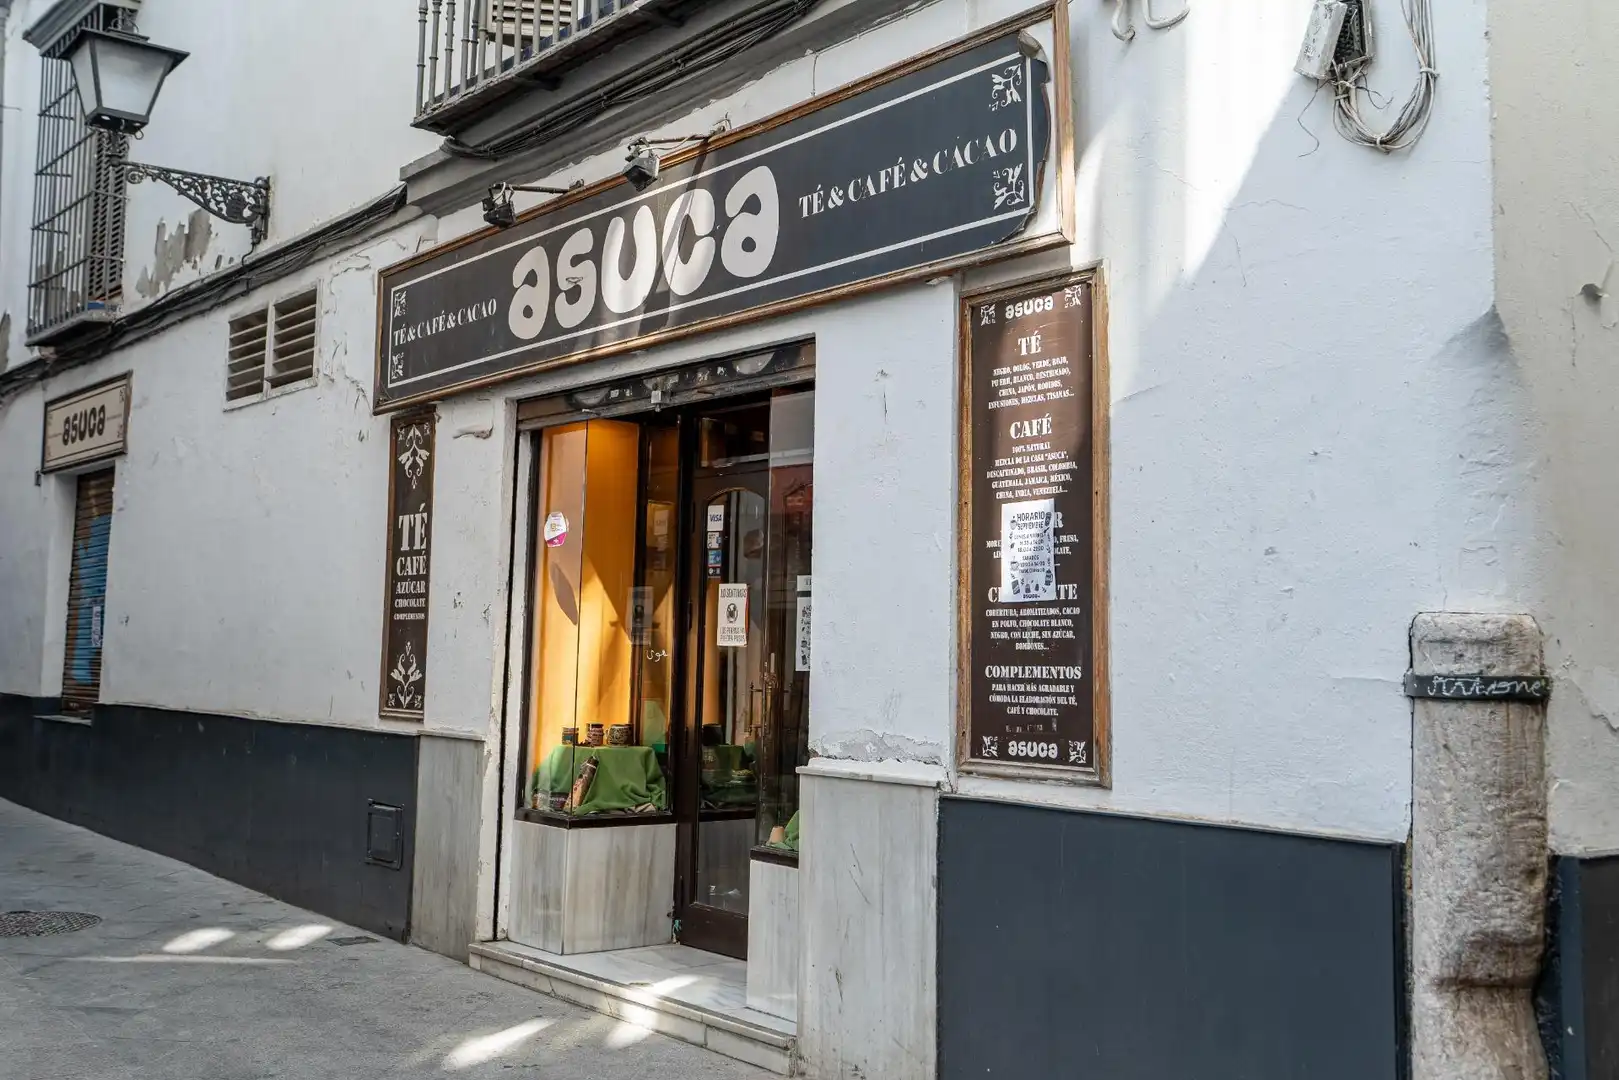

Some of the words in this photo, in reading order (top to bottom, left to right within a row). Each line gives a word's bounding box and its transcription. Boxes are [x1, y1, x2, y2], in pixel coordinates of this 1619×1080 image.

[508, 165, 780, 340] asuca
[1005, 296, 1053, 319] asuca
[1017, 330, 1041, 356] TÉ
[993, 367, 1012, 376] NEGRO,
[1032, 359, 1051, 369] VERDE,
[63, 404, 105, 446] asuca
[1010, 413, 1052, 439] CAFÉ
[1027, 442, 1050, 451] NATURAL
[1031, 454, 1044, 462] CASA
[709, 514, 722, 522] VISA
[1017, 511, 1045, 521] HORARIO
[399, 503, 428, 551] TÉ
[396, 550, 427, 577] CAFÉ
[395, 578, 426, 595] AZÚCAR
[395, 598, 426, 608] CHOCOLATE
[1051, 619, 1073, 627] BLANCO,
[991, 631, 1009, 639] NEGRO,
[1022, 631, 1040, 639] LECHE,
[1052, 629, 1075, 639] AZÚCAR,
[985, 666, 1081, 679] COMPLEMENTOS
[1007, 684, 1024, 692] HACER
[1026, 683, 1037, 692] MÁS
[1038, 684, 1070, 692] AGRADABLE
[989, 693, 1010, 702] CÓMODA
[1057, 696, 1067, 704] DEL
[1068, 695, 1077, 706] TÉ,
[1007, 706, 1020, 714] CAFÉ
[1008, 741, 1058, 758] asuca
